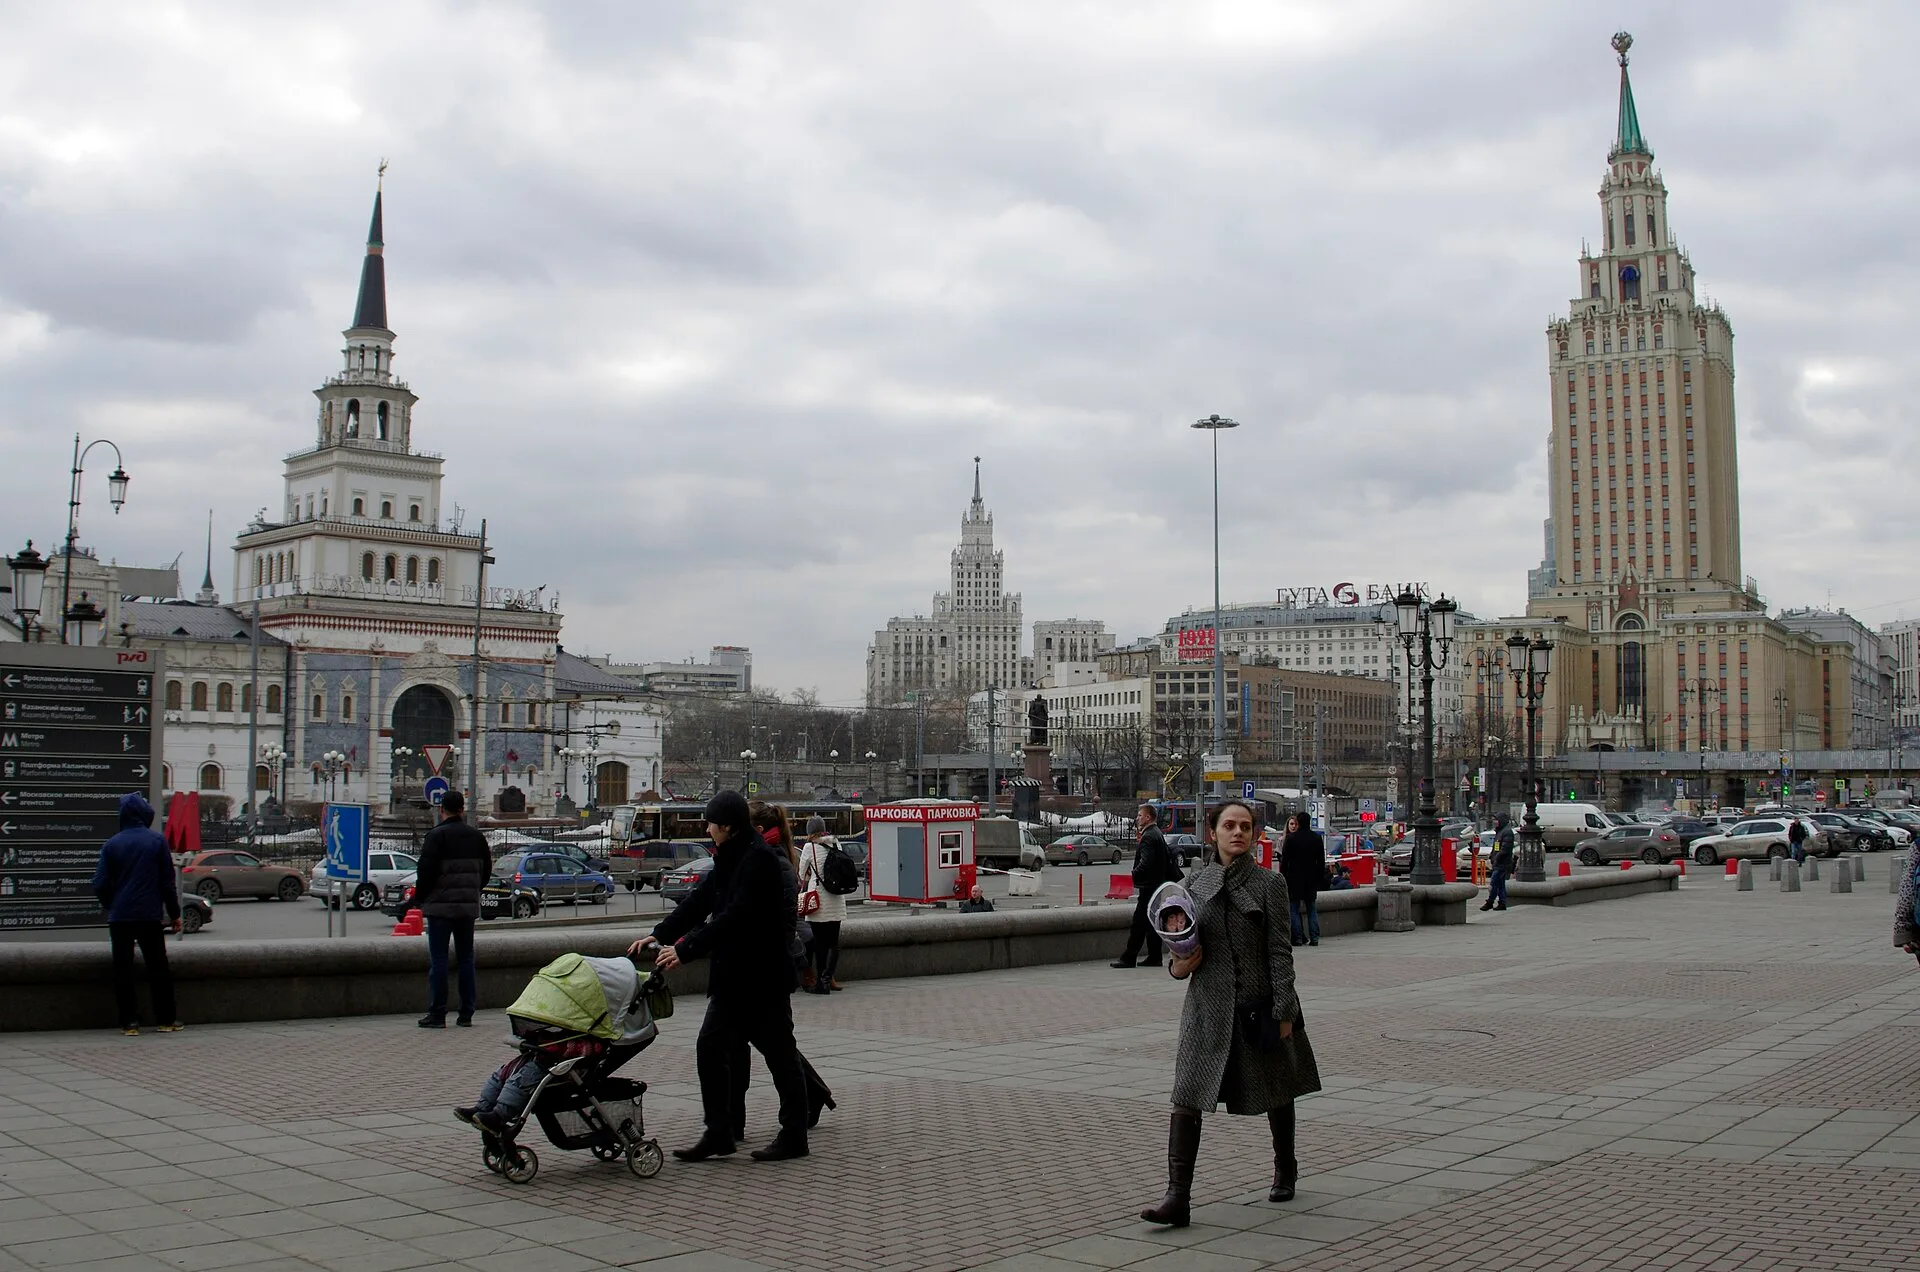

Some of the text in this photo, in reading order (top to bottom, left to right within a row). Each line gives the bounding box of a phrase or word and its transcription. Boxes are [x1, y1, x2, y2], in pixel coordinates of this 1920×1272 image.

[312, 572, 543, 611] КАЗАНСКИЙ ВОКЗАЛ
[1276, 581, 1430, 603] ГУТА БАНК
[23, 674, 69, 684] Ярославский
[58, 684, 81, 693] Railway
[21, 703, 59, 712] Казанский
[21, 711, 50, 720] Kazansky
[50, 712, 75, 721] Railway
[21, 733, 44, 741] Метро
[20, 762, 61, 770] Платформа
[20, 791, 63, 799] Московское
[866, 808, 923, 819] ПАРКОВКА
[927, 807, 978, 819] ПАРКОВКА
[46, 824, 69, 832] Railway
[70, 824, 94, 832] Agency
[18, 849, 102, 857] Театрально-концертны
